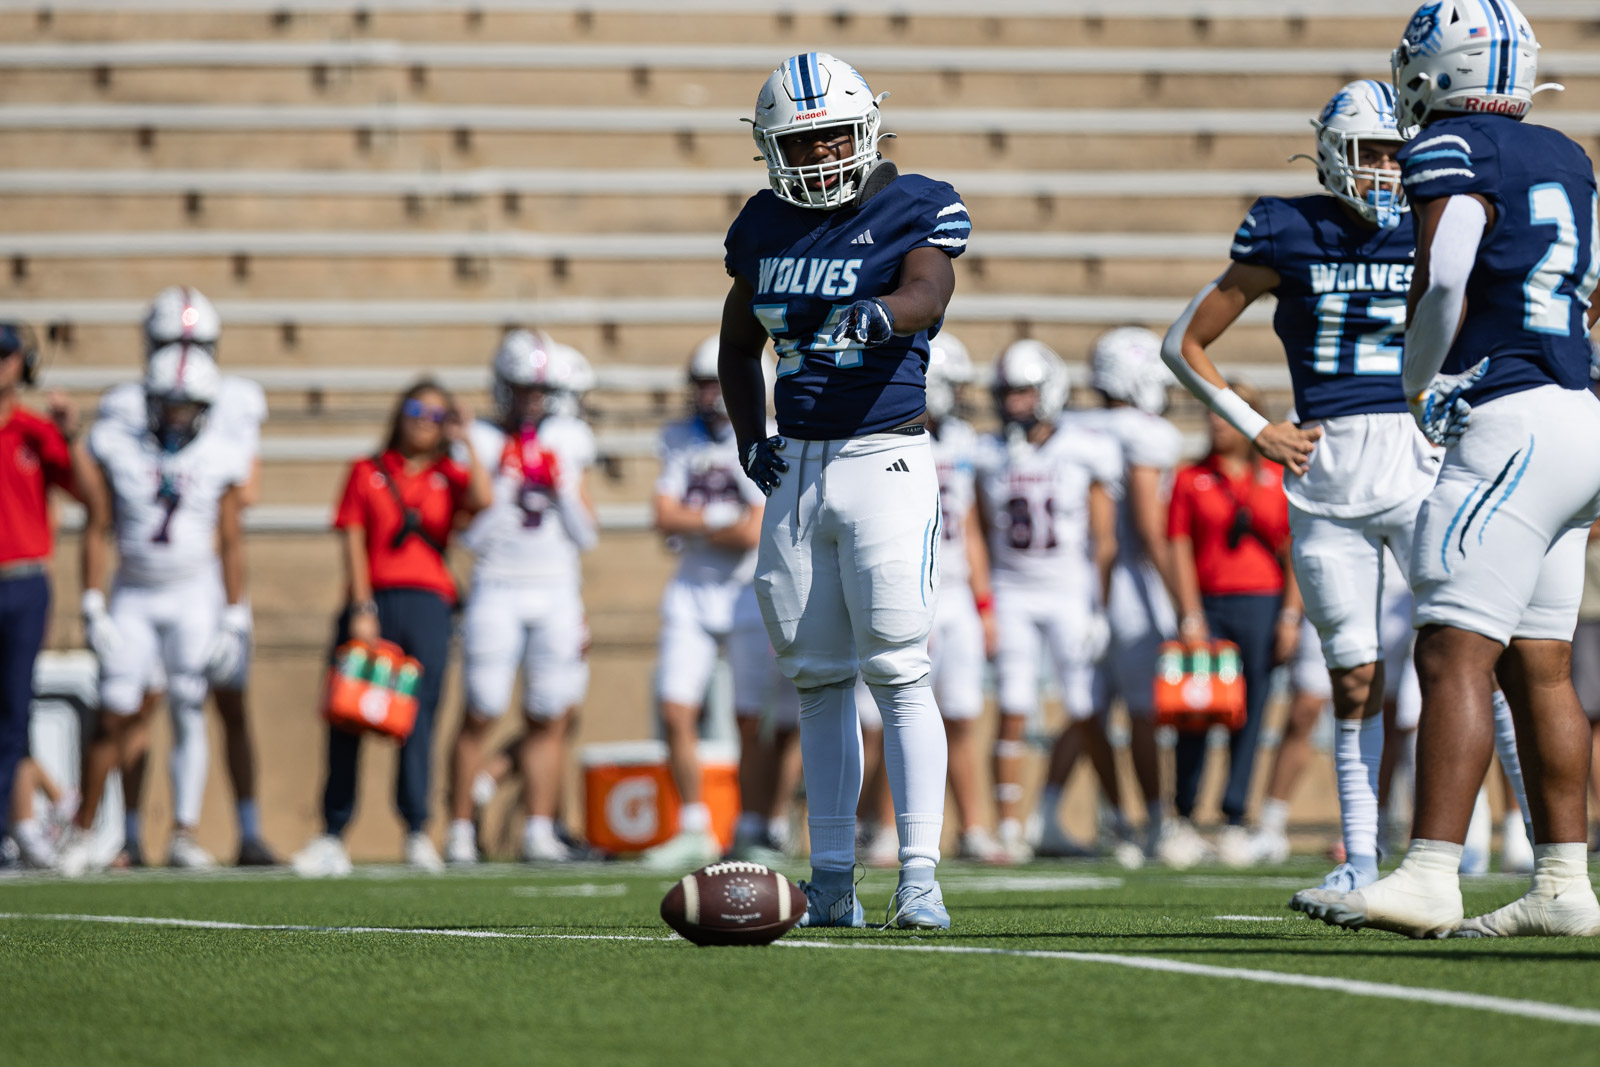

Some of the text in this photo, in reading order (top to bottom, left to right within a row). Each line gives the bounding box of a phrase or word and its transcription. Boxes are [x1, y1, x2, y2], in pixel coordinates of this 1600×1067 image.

[795, 109, 828, 121] Riddell
[1465, 97, 1527, 114] Riddell
[757, 257, 864, 297] WOLVES
[753, 303, 865, 379] 54
[1313, 292, 1407, 376] 12
[605, 775, 659, 844] G
[829, 888, 854, 925] NIKE
